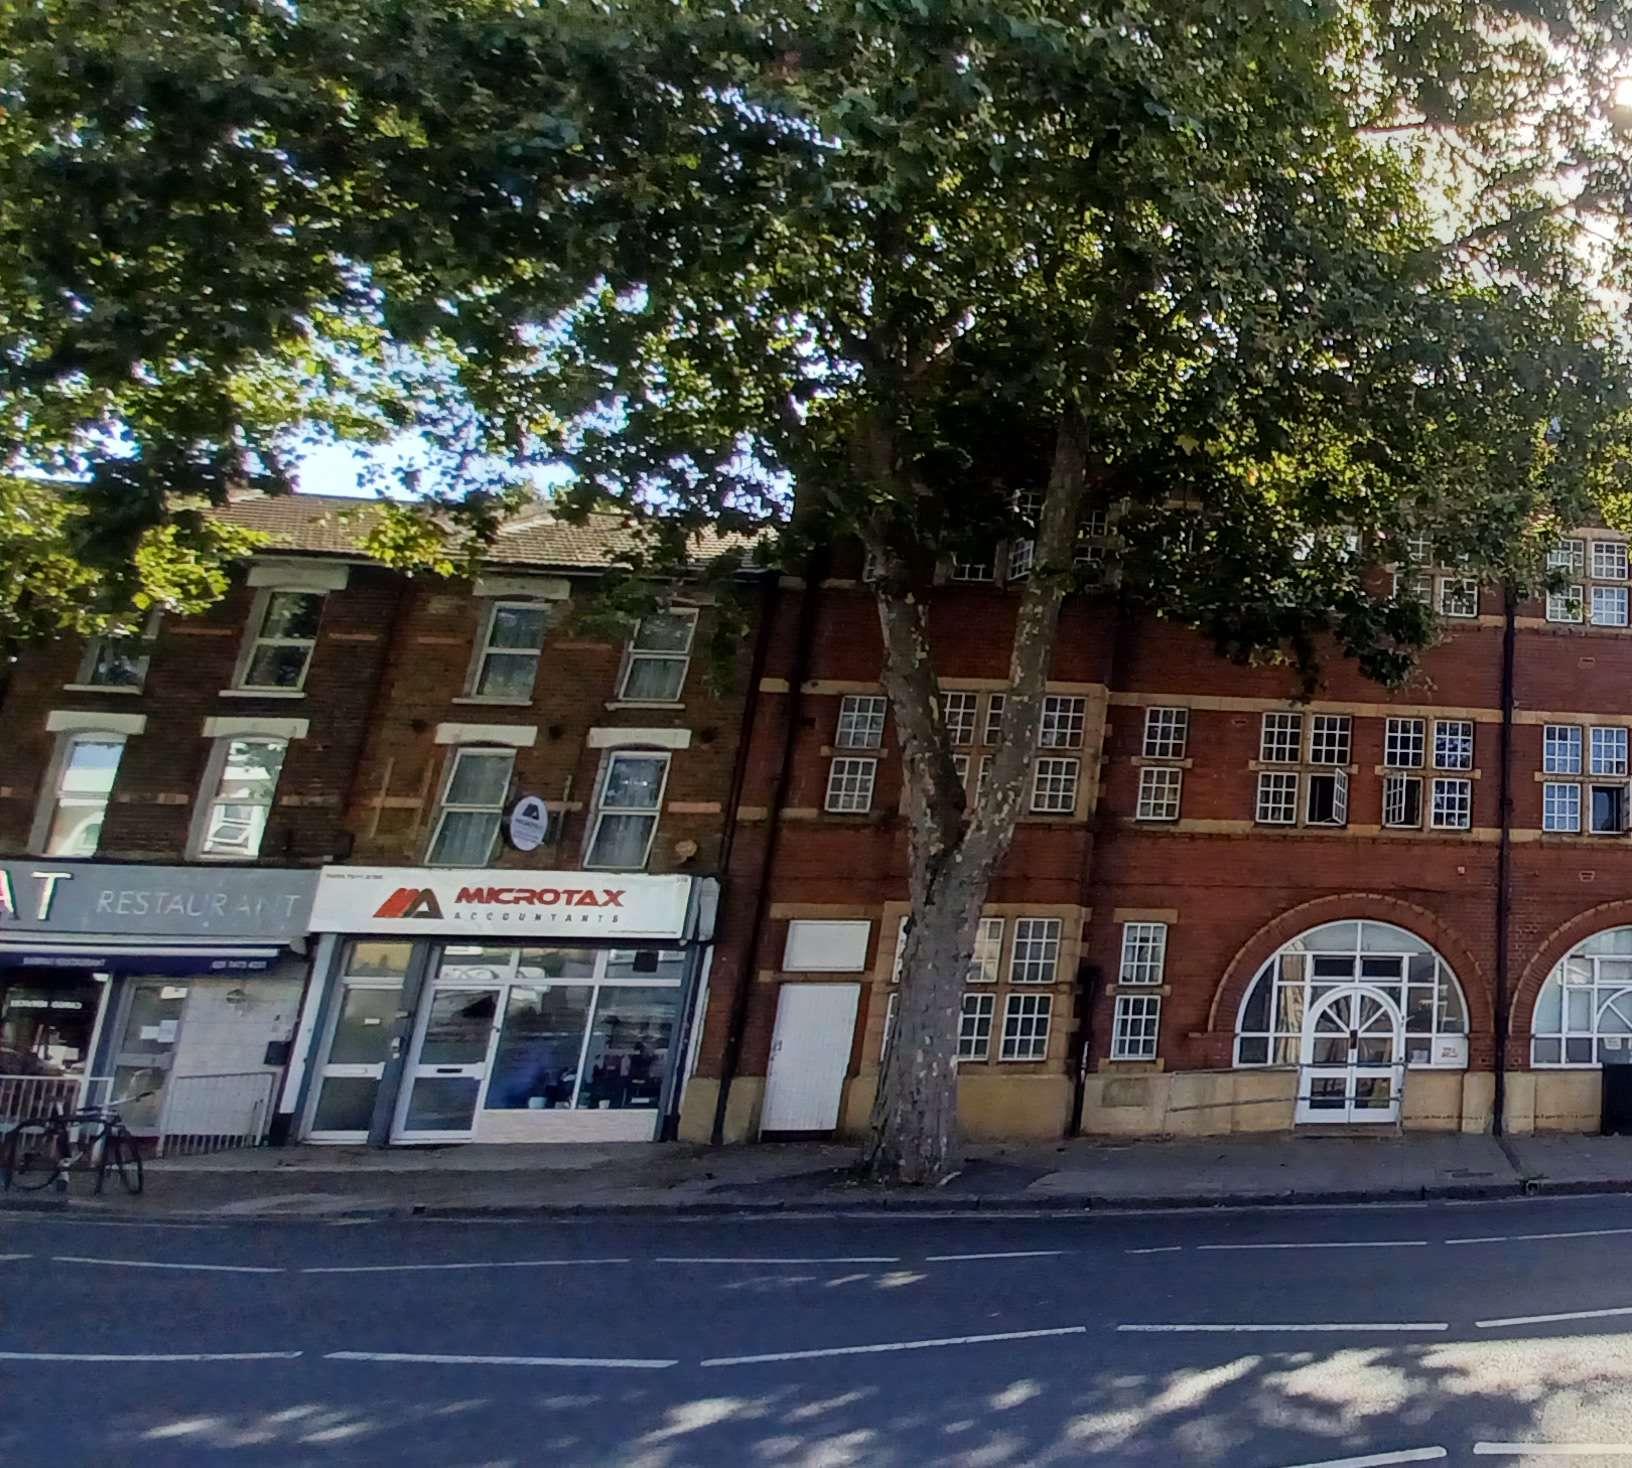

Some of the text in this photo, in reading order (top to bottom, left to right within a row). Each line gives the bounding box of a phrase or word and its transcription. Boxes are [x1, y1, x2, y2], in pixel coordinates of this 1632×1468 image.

[97, 890, 300, 917] RESTAURANT
[454, 886, 626, 908] MICROTAX
[454, 911, 619, 923] ACCOUNTANTS
